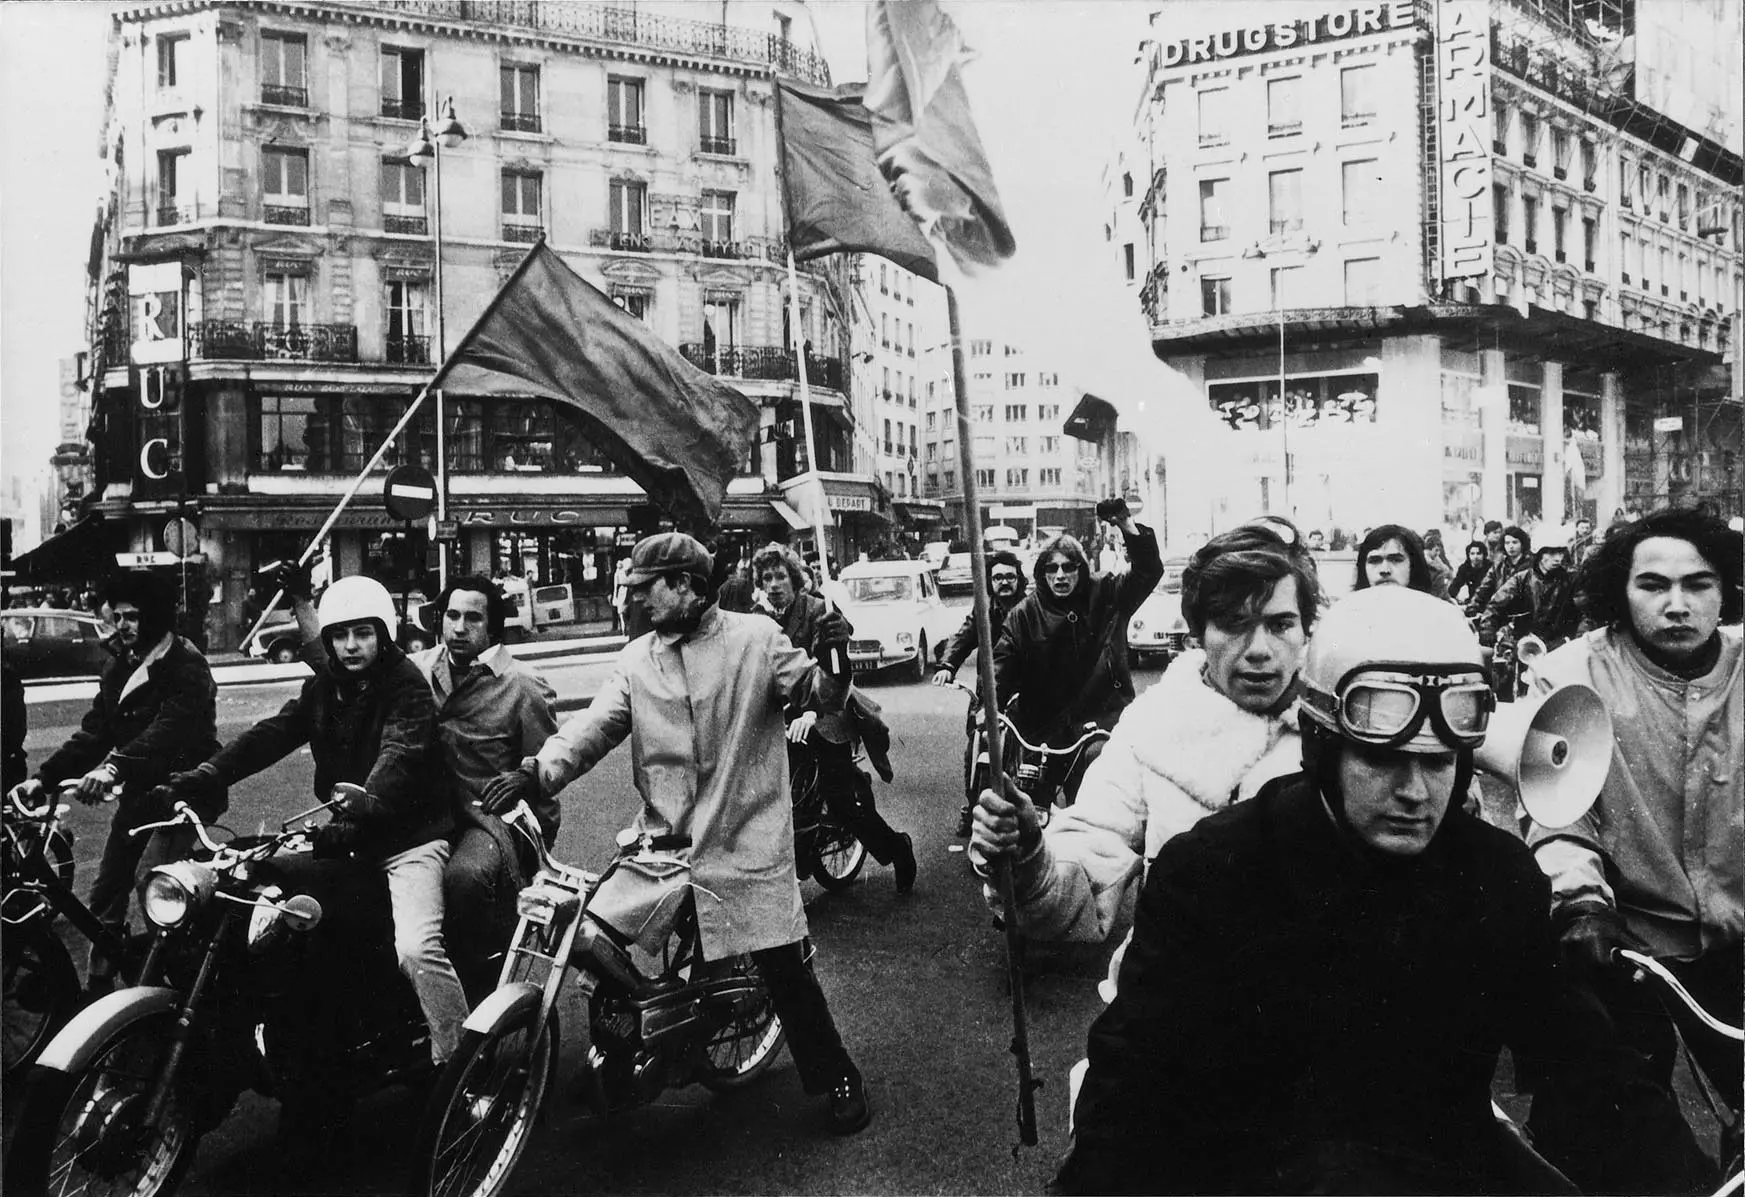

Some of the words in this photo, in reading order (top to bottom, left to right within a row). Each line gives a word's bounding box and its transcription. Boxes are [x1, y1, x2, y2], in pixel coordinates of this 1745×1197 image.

[1160, 1, 1415, 67] DRUGSTORE
[1443, 0, 1488, 278] ARMACIE
[139, 291, 168, 480] RUC
[462, 510, 581, 526] RUC
